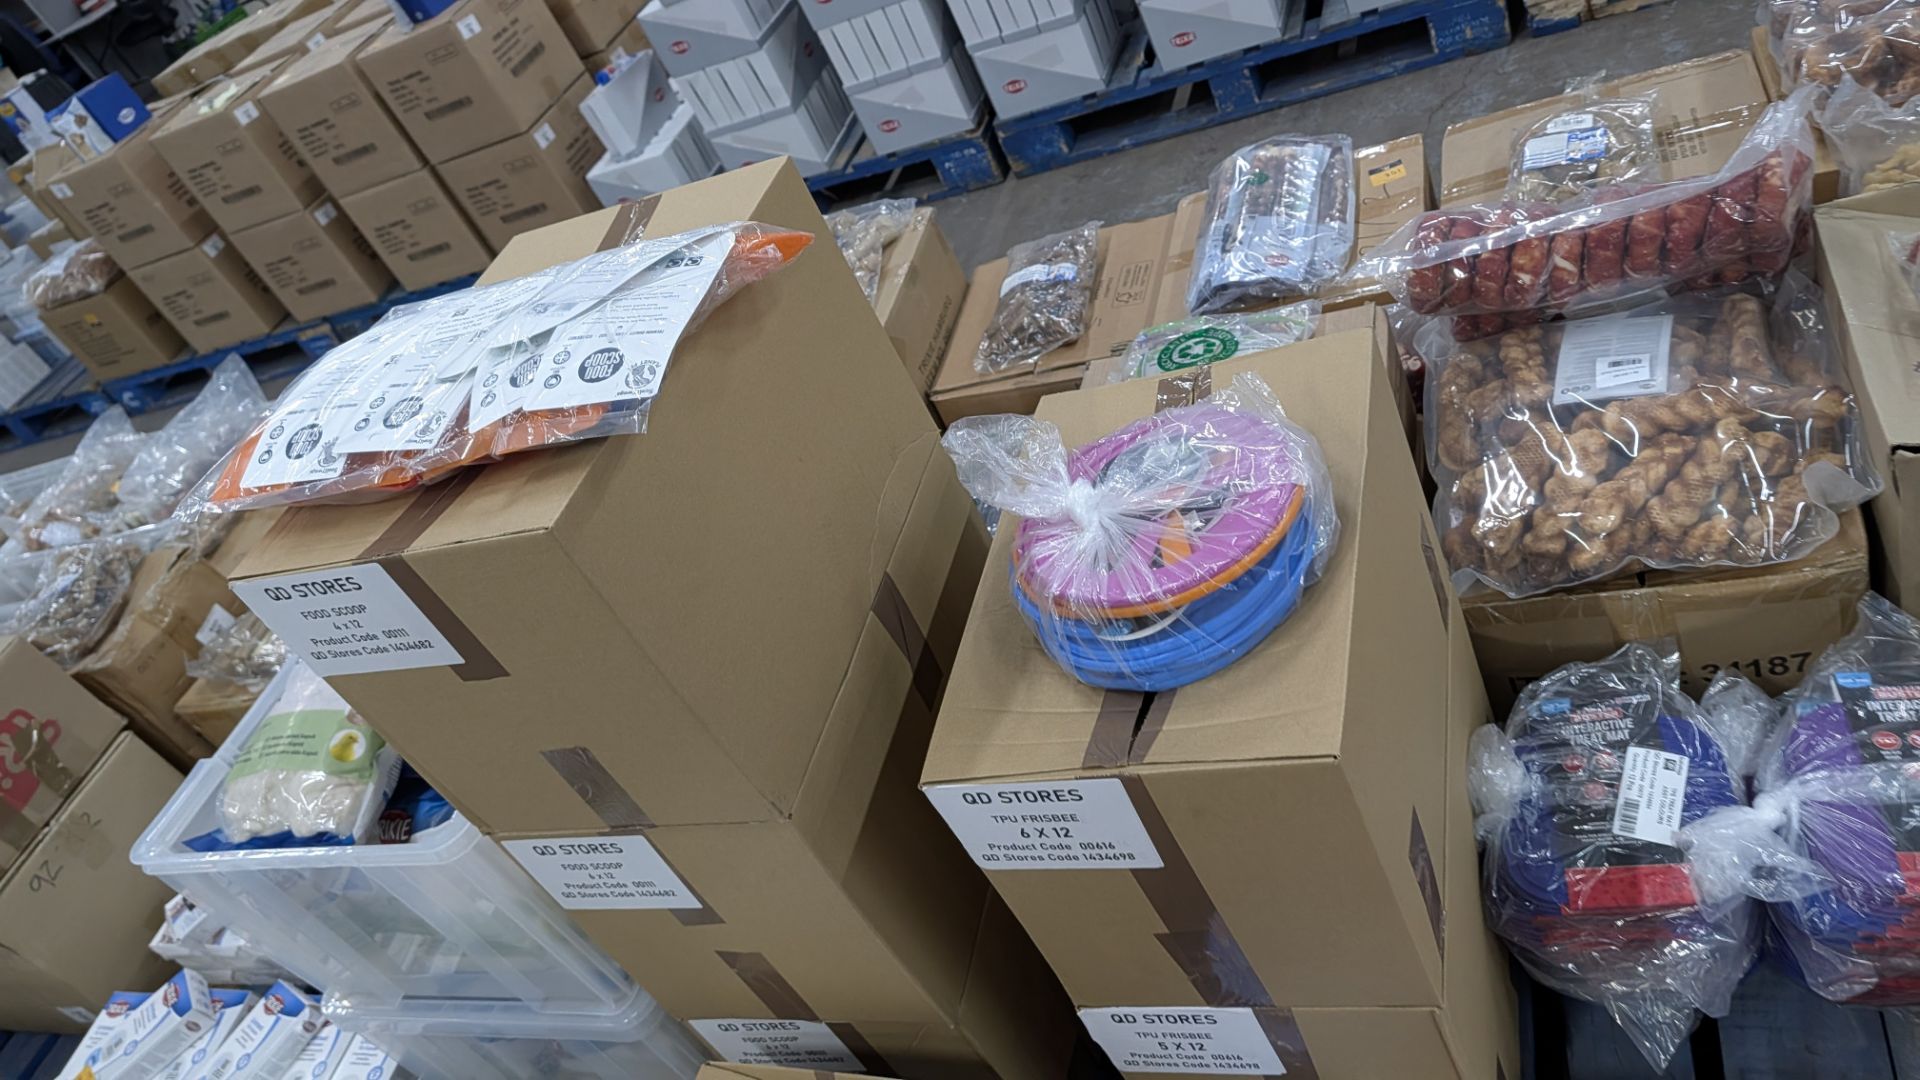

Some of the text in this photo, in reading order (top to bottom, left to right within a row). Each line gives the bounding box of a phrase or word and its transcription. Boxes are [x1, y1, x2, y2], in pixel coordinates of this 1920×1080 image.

[584, 351, 624, 367] SCOOP
[583, 365, 614, 380] FOOD
[264, 577, 362, 601] QD STORES
[300, 604, 367, 620] FOOD SCOOP
[348, 620, 364, 629] 12
[310, 628, 408, 648] Product Code 00111
[310, 639, 434, 660] QD Stores Code 1434682
[1701, 651, 1812, 682] 3187
[962, 789, 1084, 805] QD STORES
[991, 813, 1080, 824] TPU FRISBEE
[1020, 827, 1073, 839] 6 X 12
[532, 843, 623, 856] QD STORES
[988, 842, 1116, 851] Product Code 00616
[982, 853, 1136, 862] QD Stores Code 1434698
[561, 862, 623, 871] FOOD SCOOP
[564, 882, 602, 890] Product
[603, 881, 627, 889] Code
[578, 890, 609, 898] Stores
[611, 890, 636, 898] Code
[1110, 1014, 1218, 1025] QD STORES
[717, 1022, 801, 1032] QD STORES
[1162, 1032, 1213, 1040] FRISBEE
[1157, 1042, 1207, 1051] 5 X 12
[1130, 1052, 1174, 1060] Product
[1141, 1060, 1180, 1068] Stores
